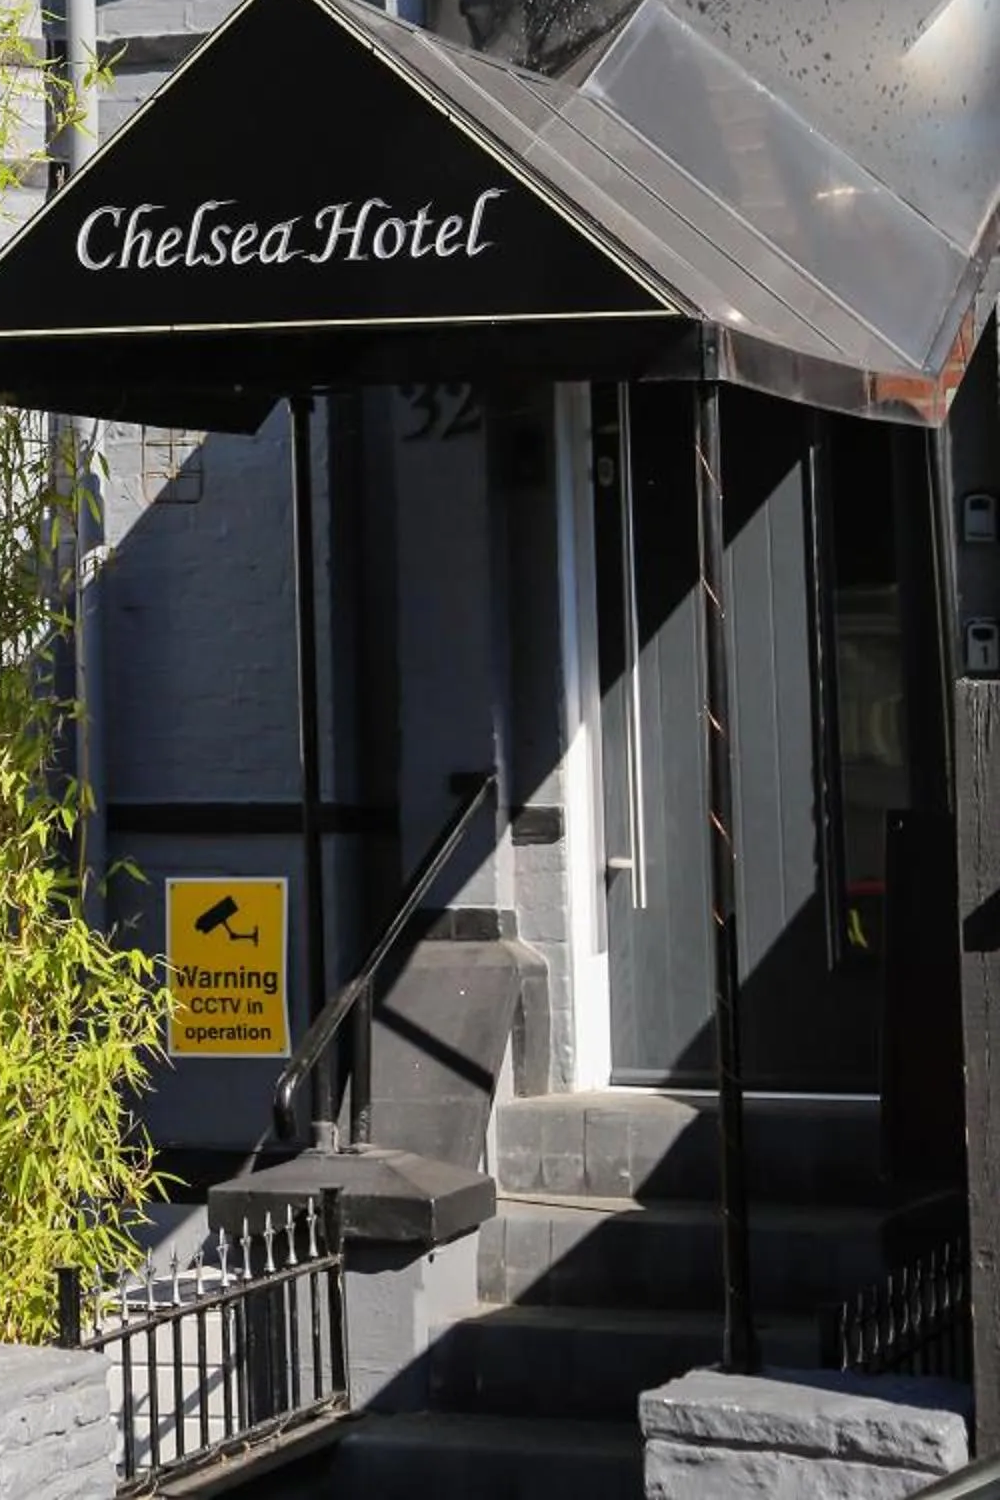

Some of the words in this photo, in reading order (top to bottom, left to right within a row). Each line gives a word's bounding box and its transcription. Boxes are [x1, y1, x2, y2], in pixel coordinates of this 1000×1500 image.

[77, 200, 303, 270] Chelsea
[303, 189, 507, 263] Hotel
[175, 965, 278, 994] Warning
[191, 997, 242, 1014] CCTV
[247, 998, 263, 1014] in
[185, 1025, 272, 1044] operation
